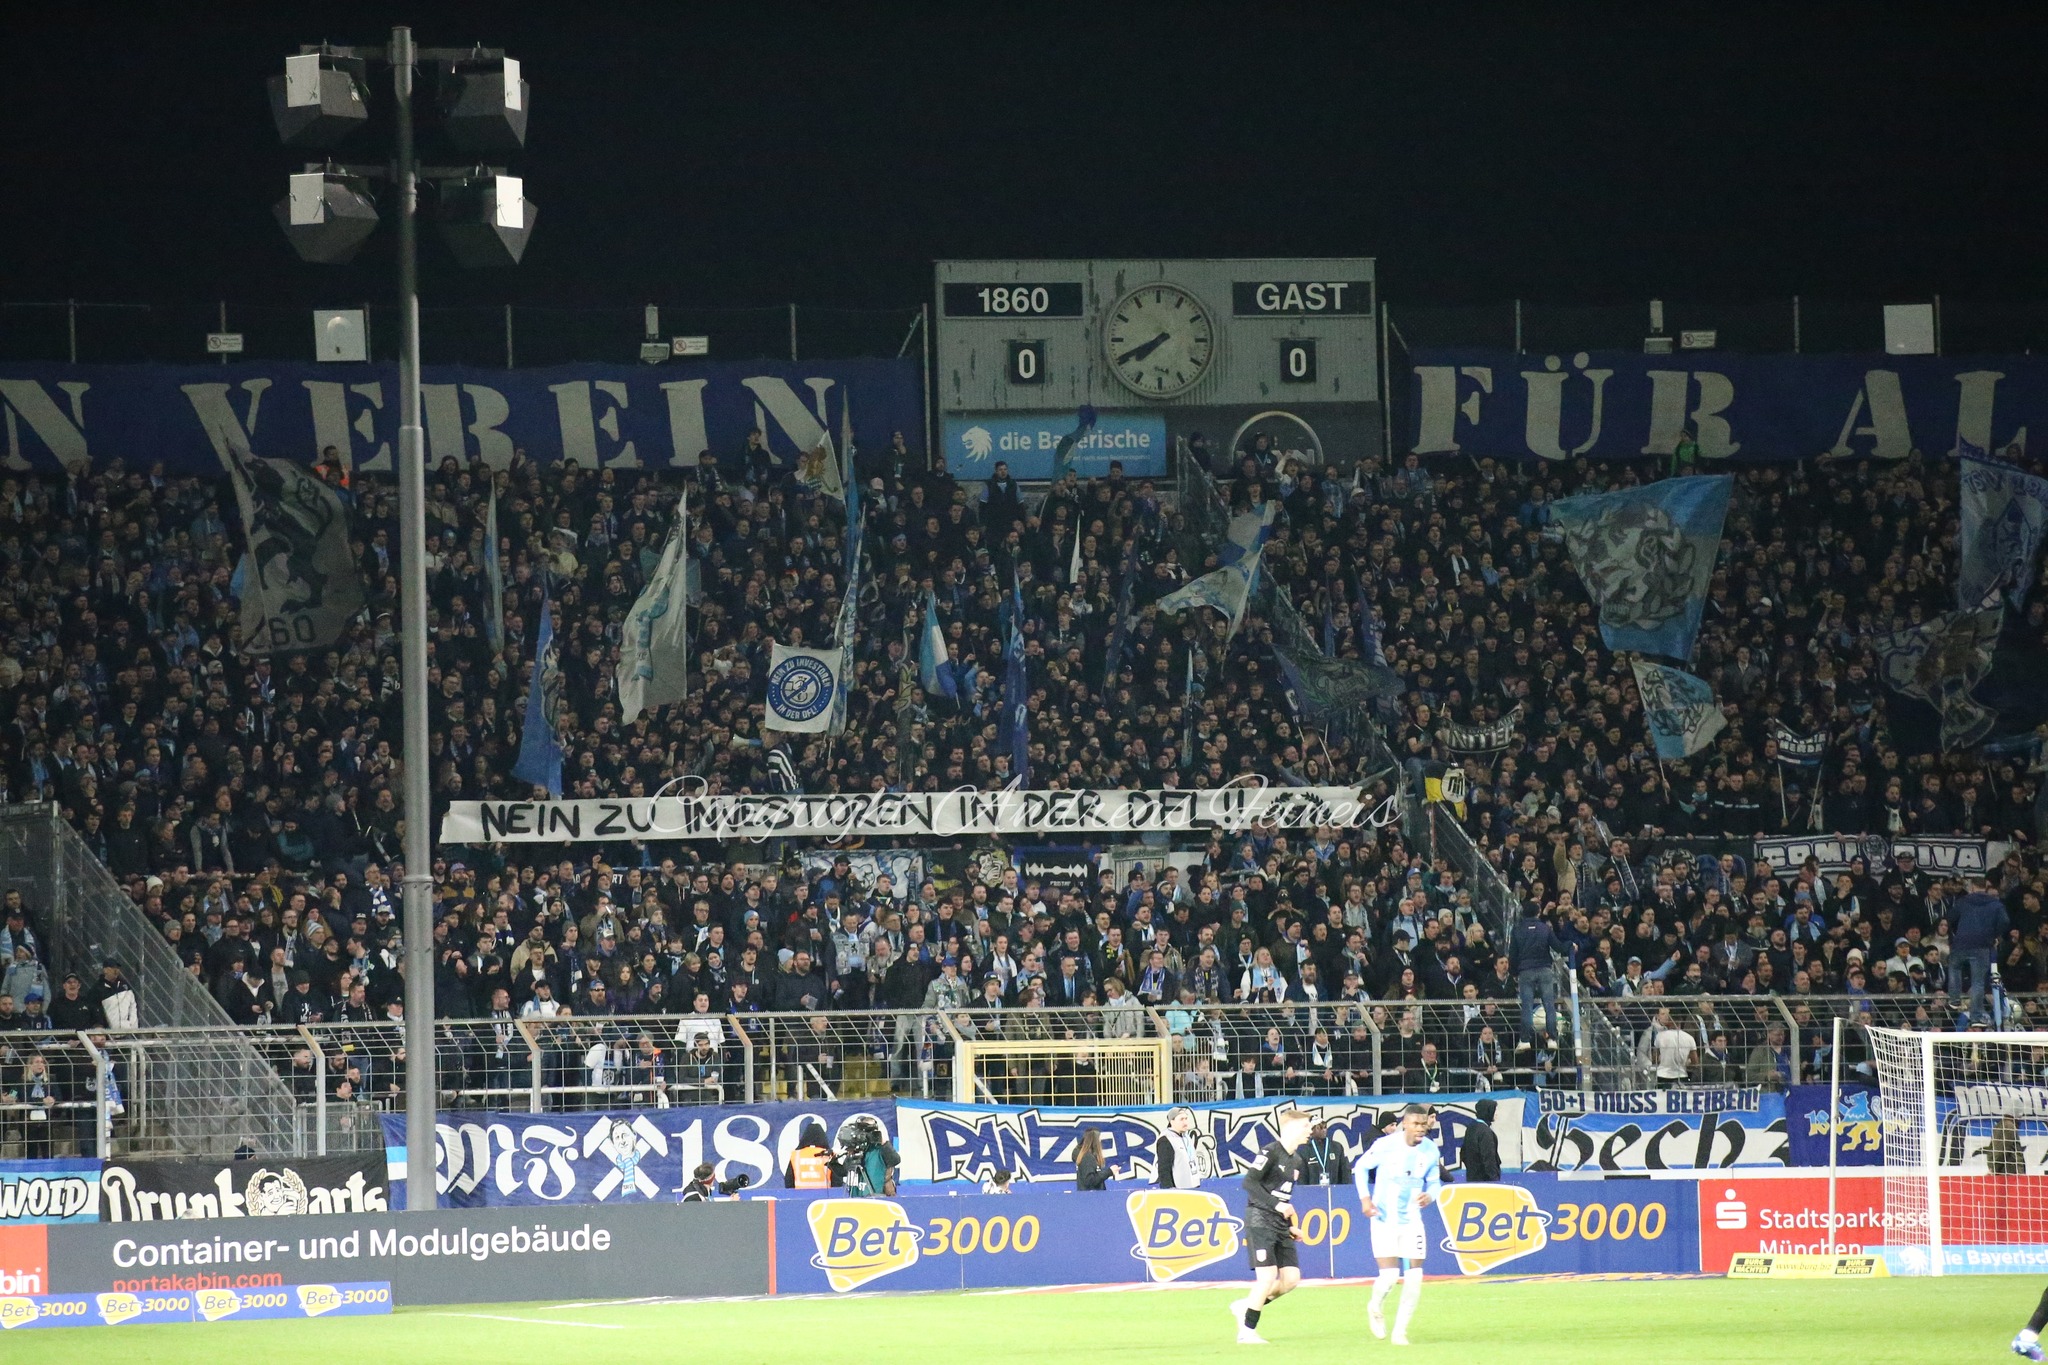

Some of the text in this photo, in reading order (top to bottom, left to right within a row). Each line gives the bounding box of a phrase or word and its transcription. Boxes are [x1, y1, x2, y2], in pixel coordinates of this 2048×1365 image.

[978, 287, 1049, 313] 1860
[1256, 283, 1348, 311] GAST
[1018, 349, 1036, 379] 0
[1289, 347, 1307, 377] 0
[1411, 351, 1742, 460] FÜR
[180, 376, 836, 472] VEREIN
[1000, 429, 1150, 450] die Baerische
[771, 658, 832, 688] NEIN ZU INVESTOREN
[785, 708, 800, 719] DER
[801, 705, 819, 719] DFL!
[481, 803, 580, 840] NEIN
[594, 797, 656, 834] ZU
[684, 794, 934, 835] INVESTOREN
[960, 792, 999, 827] IN
[1024, 789, 1109, 828] DER
[1540, 1088, 1759, 1113] 50+1 MUSS BLEIBEN!
[1148, 1207, 1222, 1249] Bet
[1457, 1202, 1667, 1242] Bet 3000
[1760, 1206, 1931, 1233] Stadtsparkasse
[112, 1223, 612, 1268] Container- und Modulgebäude
[826, 1214, 1040, 1258] Bet 3000
[1760, 1238, 1862, 1254] München
[1744, 1258, 1765, 1267] BURG
[1845, 1259, 1866, 1267] BURG
[1966, 1249, 2048, 1267] Bayerisc
[0, 1268, 41, 1294] bin
[112, 1272, 283, 1291] portakabin.com
[2, 1301, 87, 1317] Bet 3000
[105, 1297, 190, 1313] Bet 3000
[203, 1293, 288, 1310] Bet 3000
[305, 1289, 389, 1306] Bet 3000
